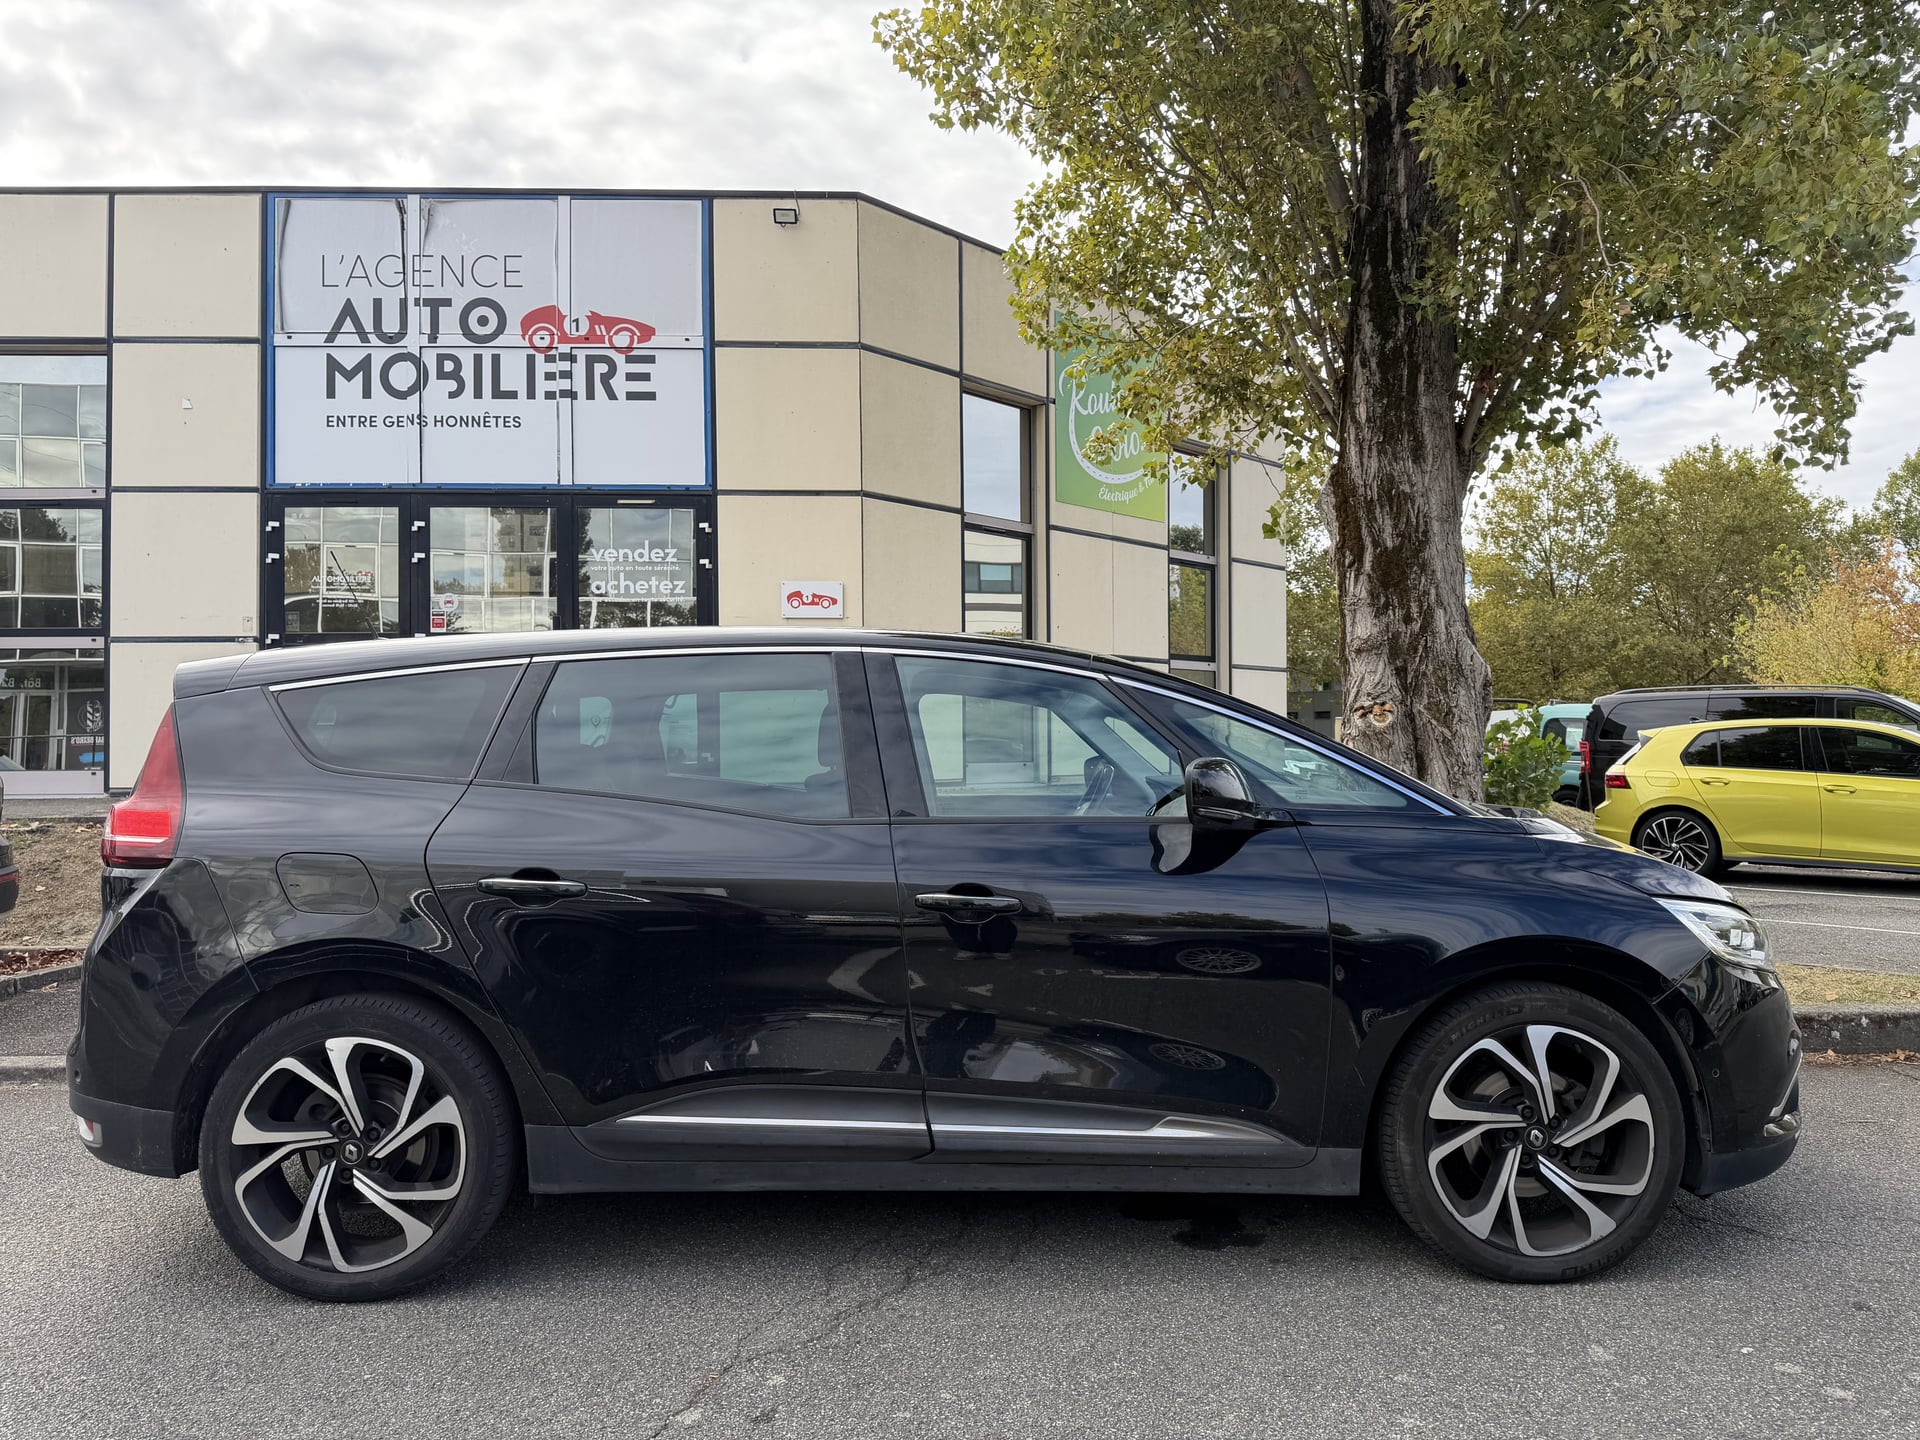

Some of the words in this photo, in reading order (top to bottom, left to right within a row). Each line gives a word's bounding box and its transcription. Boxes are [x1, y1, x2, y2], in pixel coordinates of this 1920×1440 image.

[321, 254, 524, 288] L'AGENCE
[323, 297, 507, 344] AUTO
[326, 414, 378, 429] ENTRE
[382, 412, 429, 429] GENS
[433, 411, 522, 429] HONNÊTES
[590, 540, 678, 562] vendez
[590, 572, 686, 594] achetez
